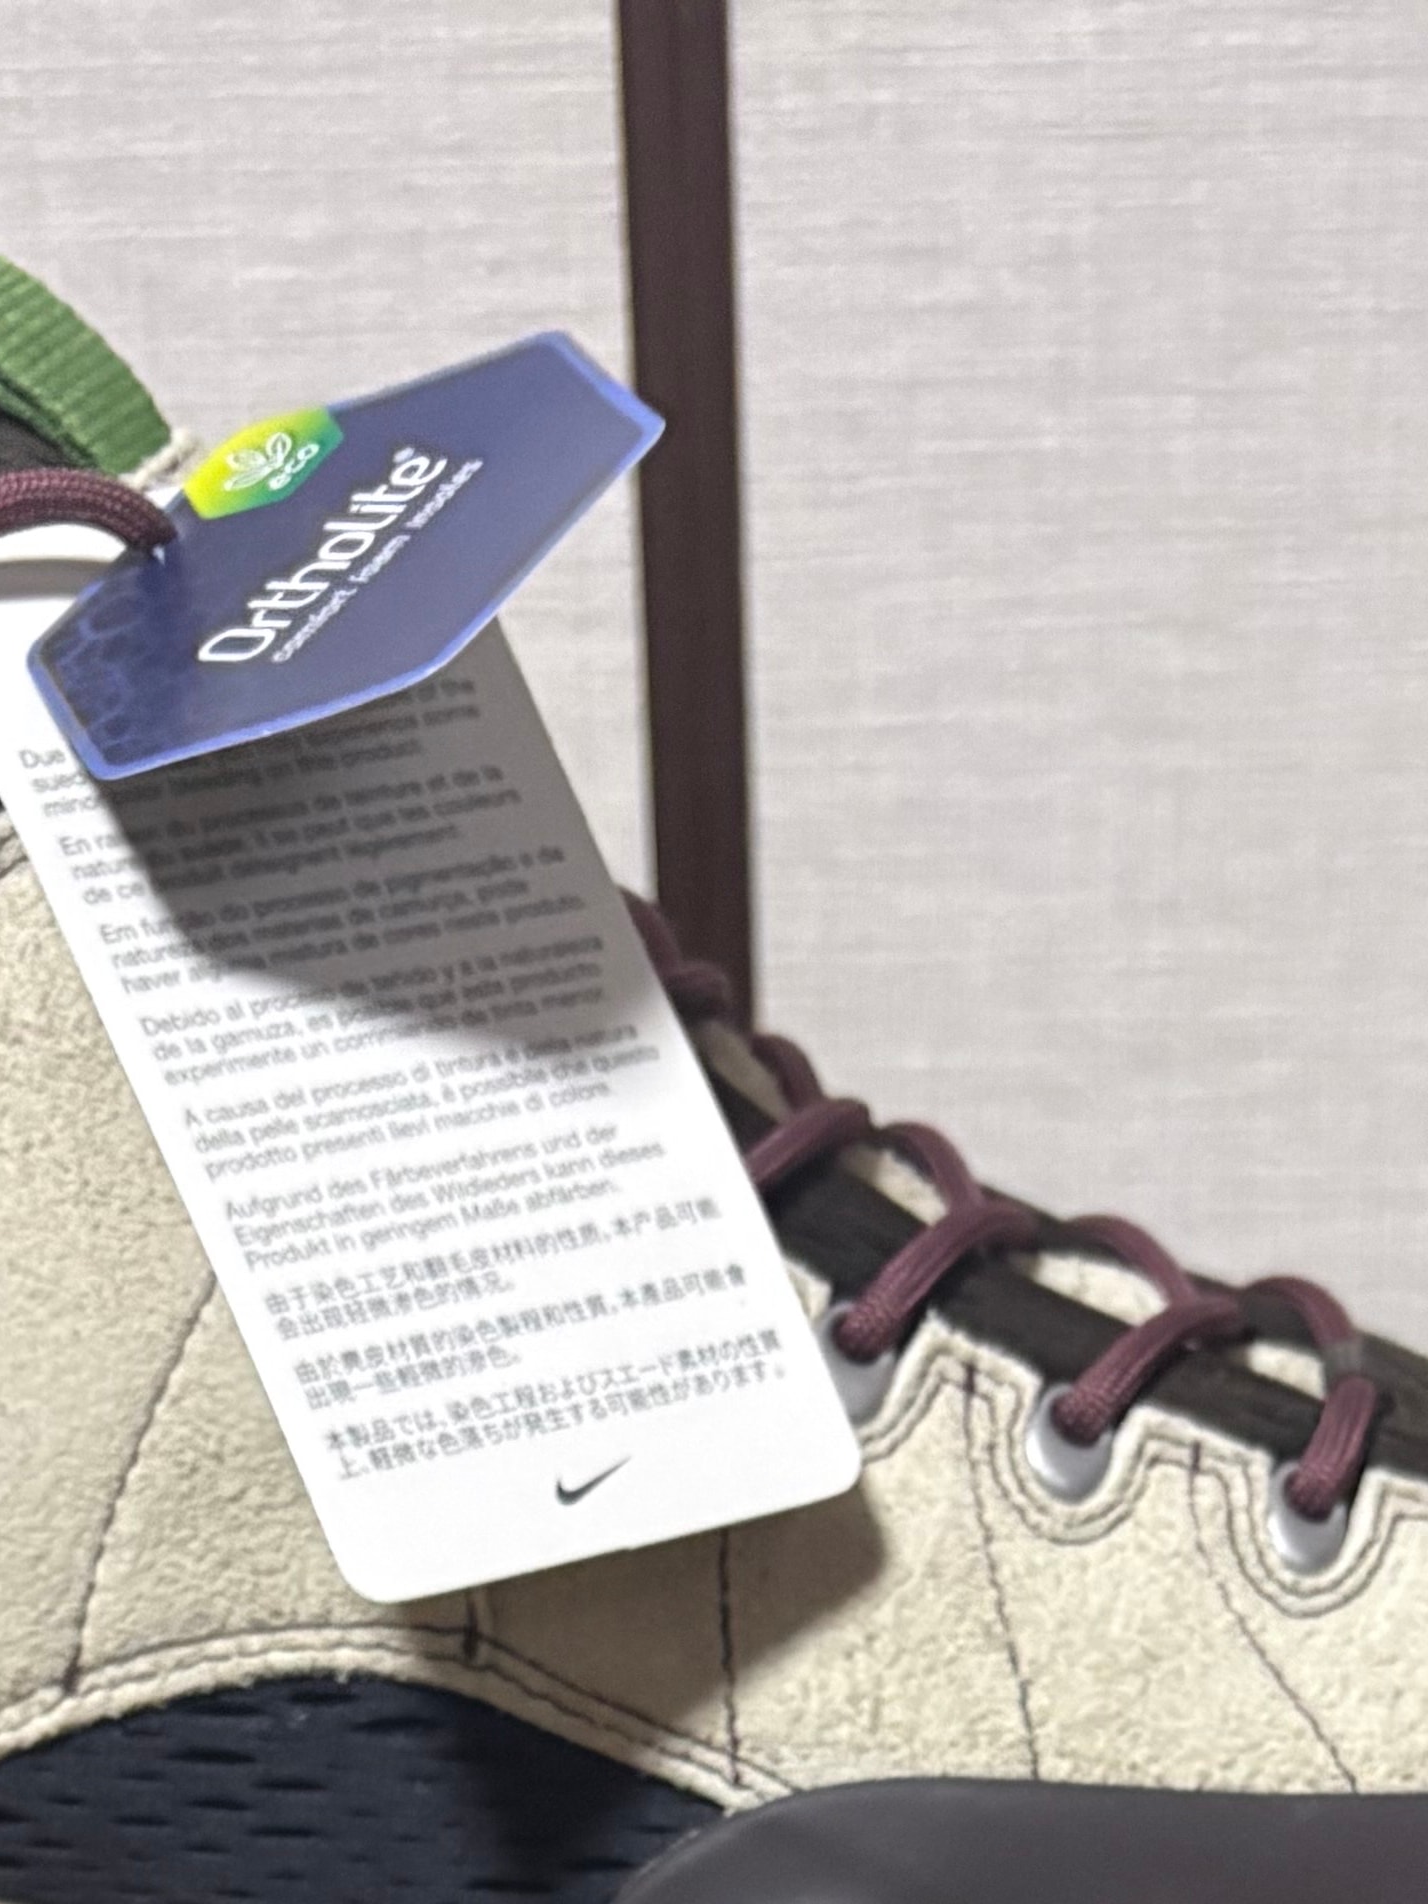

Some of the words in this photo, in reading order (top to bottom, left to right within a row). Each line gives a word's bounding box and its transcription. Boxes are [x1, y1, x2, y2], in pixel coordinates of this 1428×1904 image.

[268, 443, 320, 490] eco
[19, 745, 66, 767] Due
[59, 835, 92, 854] En
[82, 887, 111, 902] de
[115, 881, 146, 897] ce
[99, 922, 139, 942] Em
[123, 970, 184, 992] haver
[141, 1007, 222, 1035] Debido
[223, 1002, 245, 1019] al
[153, 1043, 182, 1059] de
[187, 1038, 207, 1053] la
[164, 1048, 299, 1085] experimente
[301, 1042, 330, 1057] un
[205, 1099, 270, 1123] causa
[272, 1088, 308, 1108] del
[311, 1071, 411, 1104] processo
[193, 1128, 245, 1151] della
[247, 1116, 302, 1145] pelle
[204, 1144, 300, 1180] prodotto
[299, 1126, 389, 1161] presenti
[433, 1099, 521, 1129] macchie
[223, 1183, 325, 1220] Aufgrund
[325, 1175, 369, 1198] des
[540, 1130, 582, 1153] und
[584, 1122, 622, 1143] der
[234, 1198, 388, 1245] Eigenschaften
[388, 1189, 430, 1212] des
[543, 1154, 596, 1179] kann
[597, 1139, 668, 1167] dieses
[245, 1237, 331, 1269] Produkt
[334, 1232, 357, 1250] in
[359, 1213, 461, 1250] geringem
